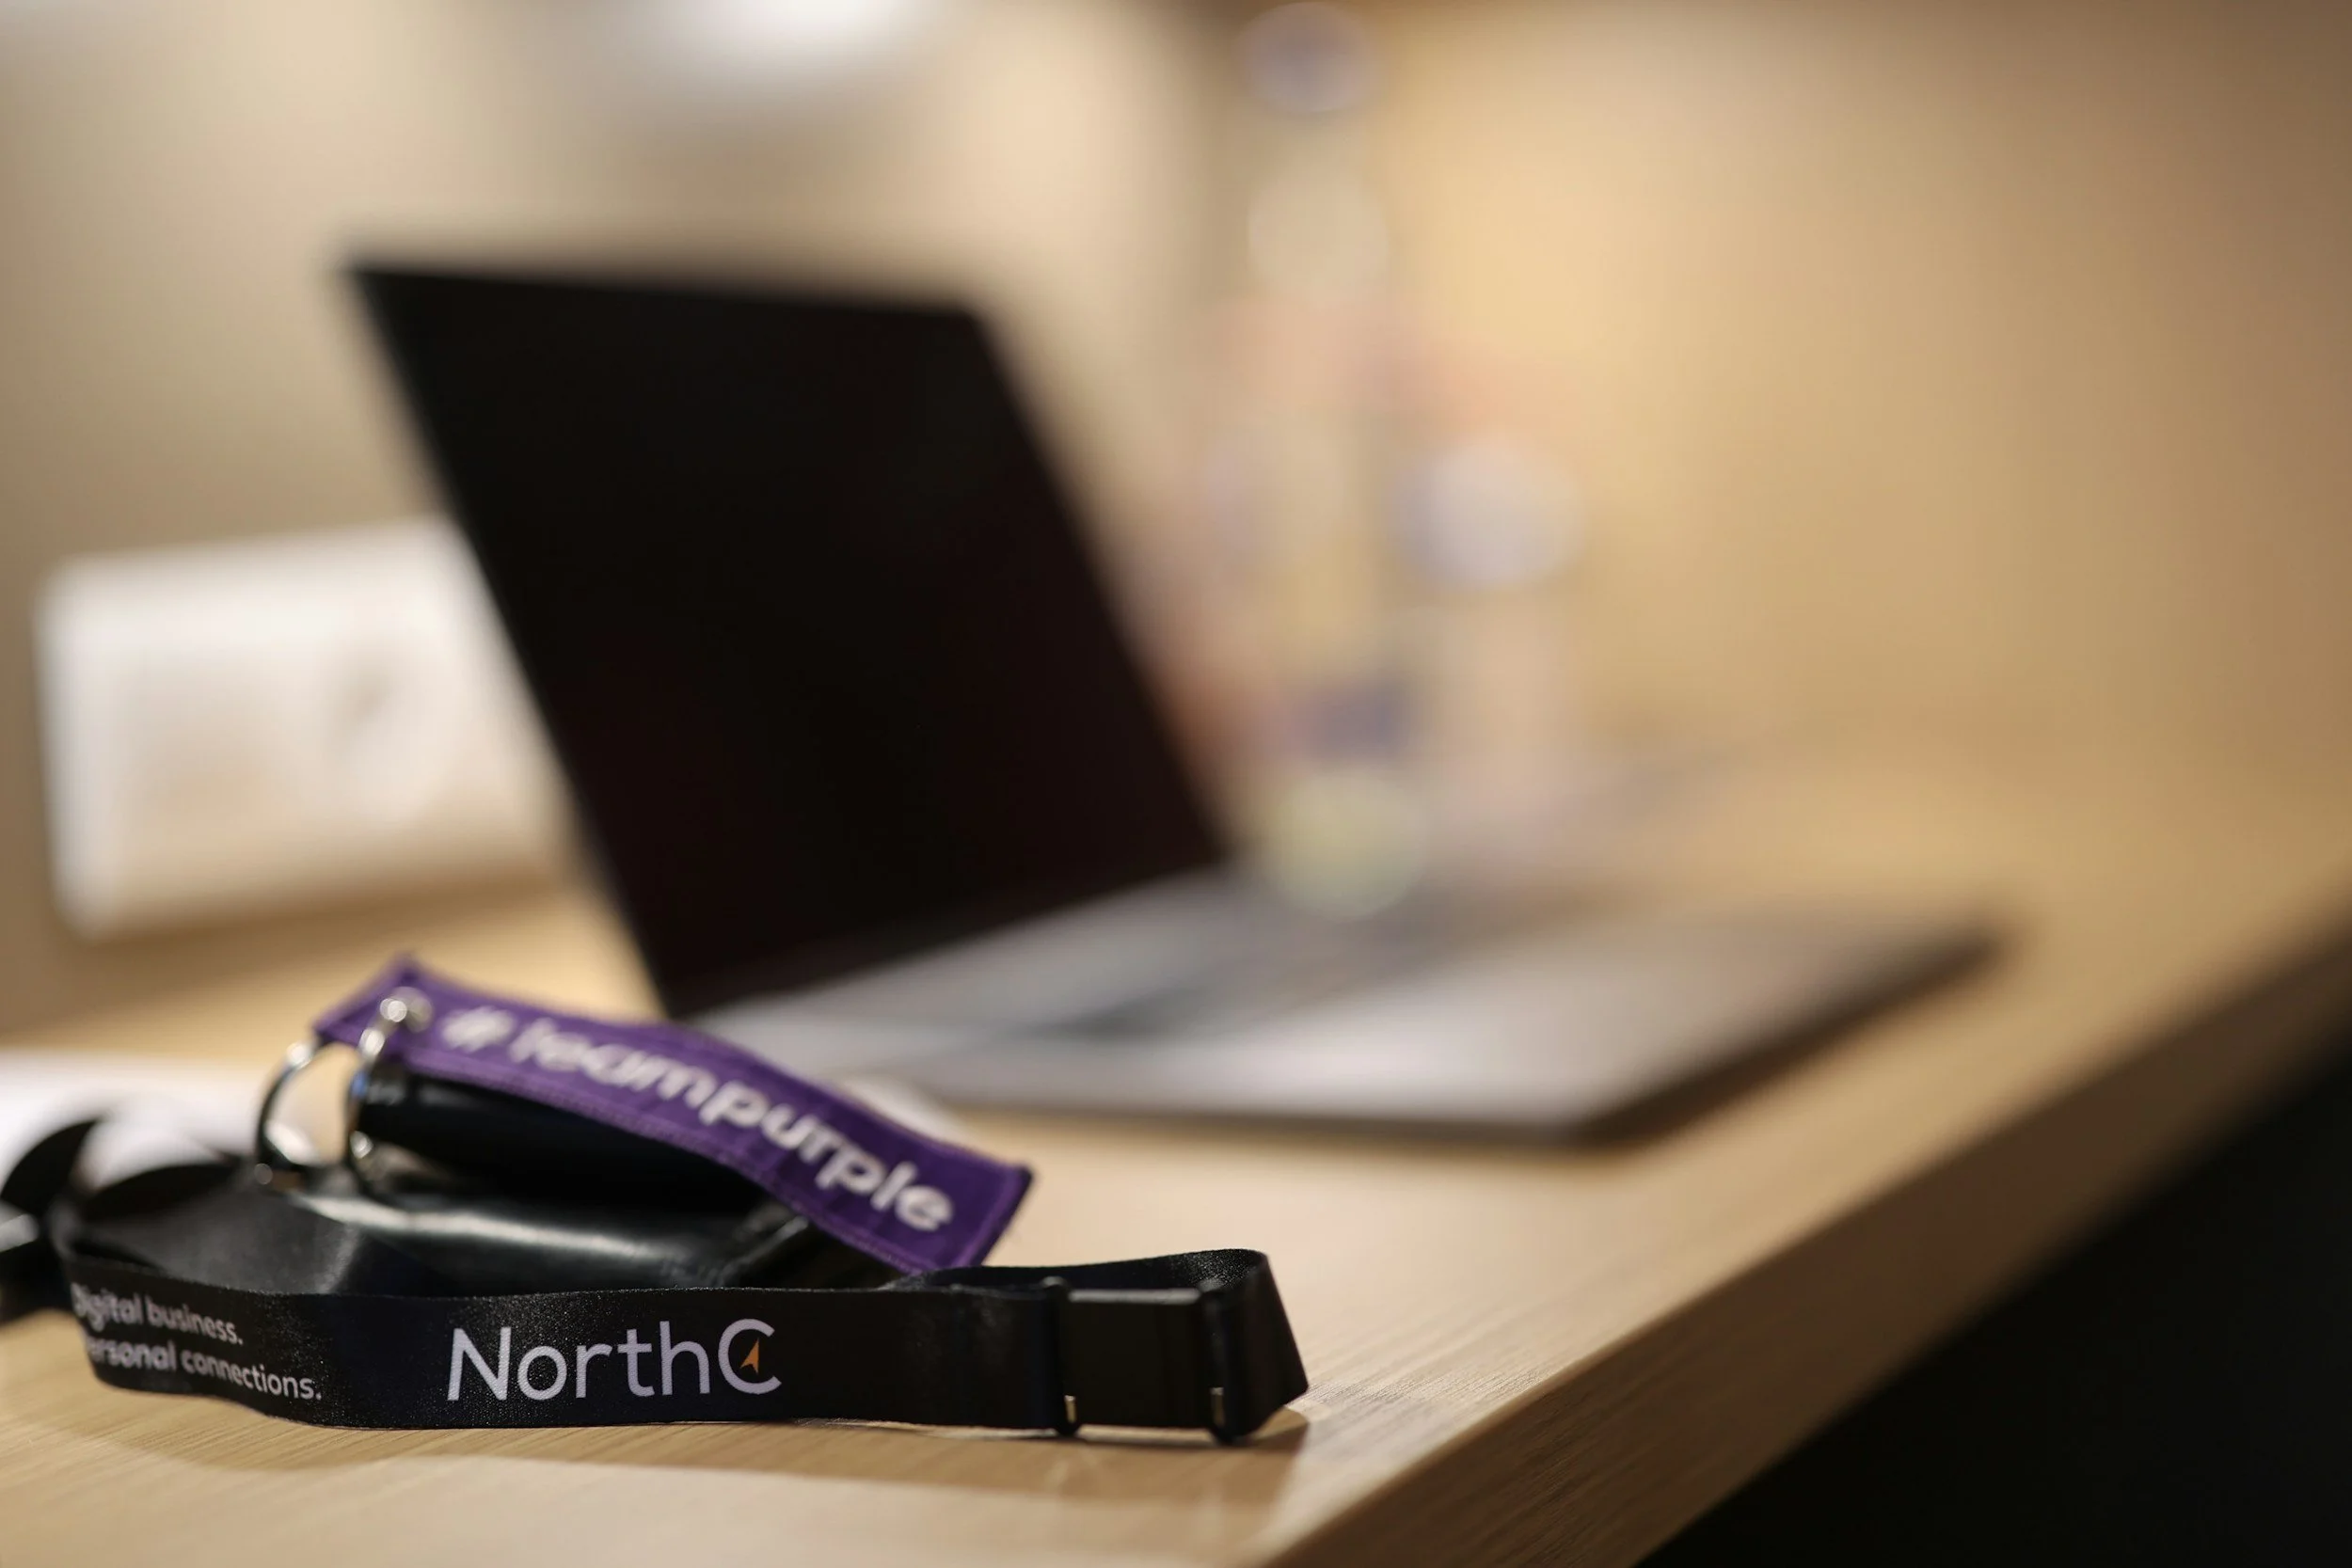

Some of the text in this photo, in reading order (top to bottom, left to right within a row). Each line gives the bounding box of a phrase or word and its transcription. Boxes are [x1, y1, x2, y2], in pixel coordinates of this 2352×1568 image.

[145, 1294, 243, 1345] business.
[86, 1336, 322, 1401] ersonal connections.
[447, 1319, 782, 1402] NorthC
